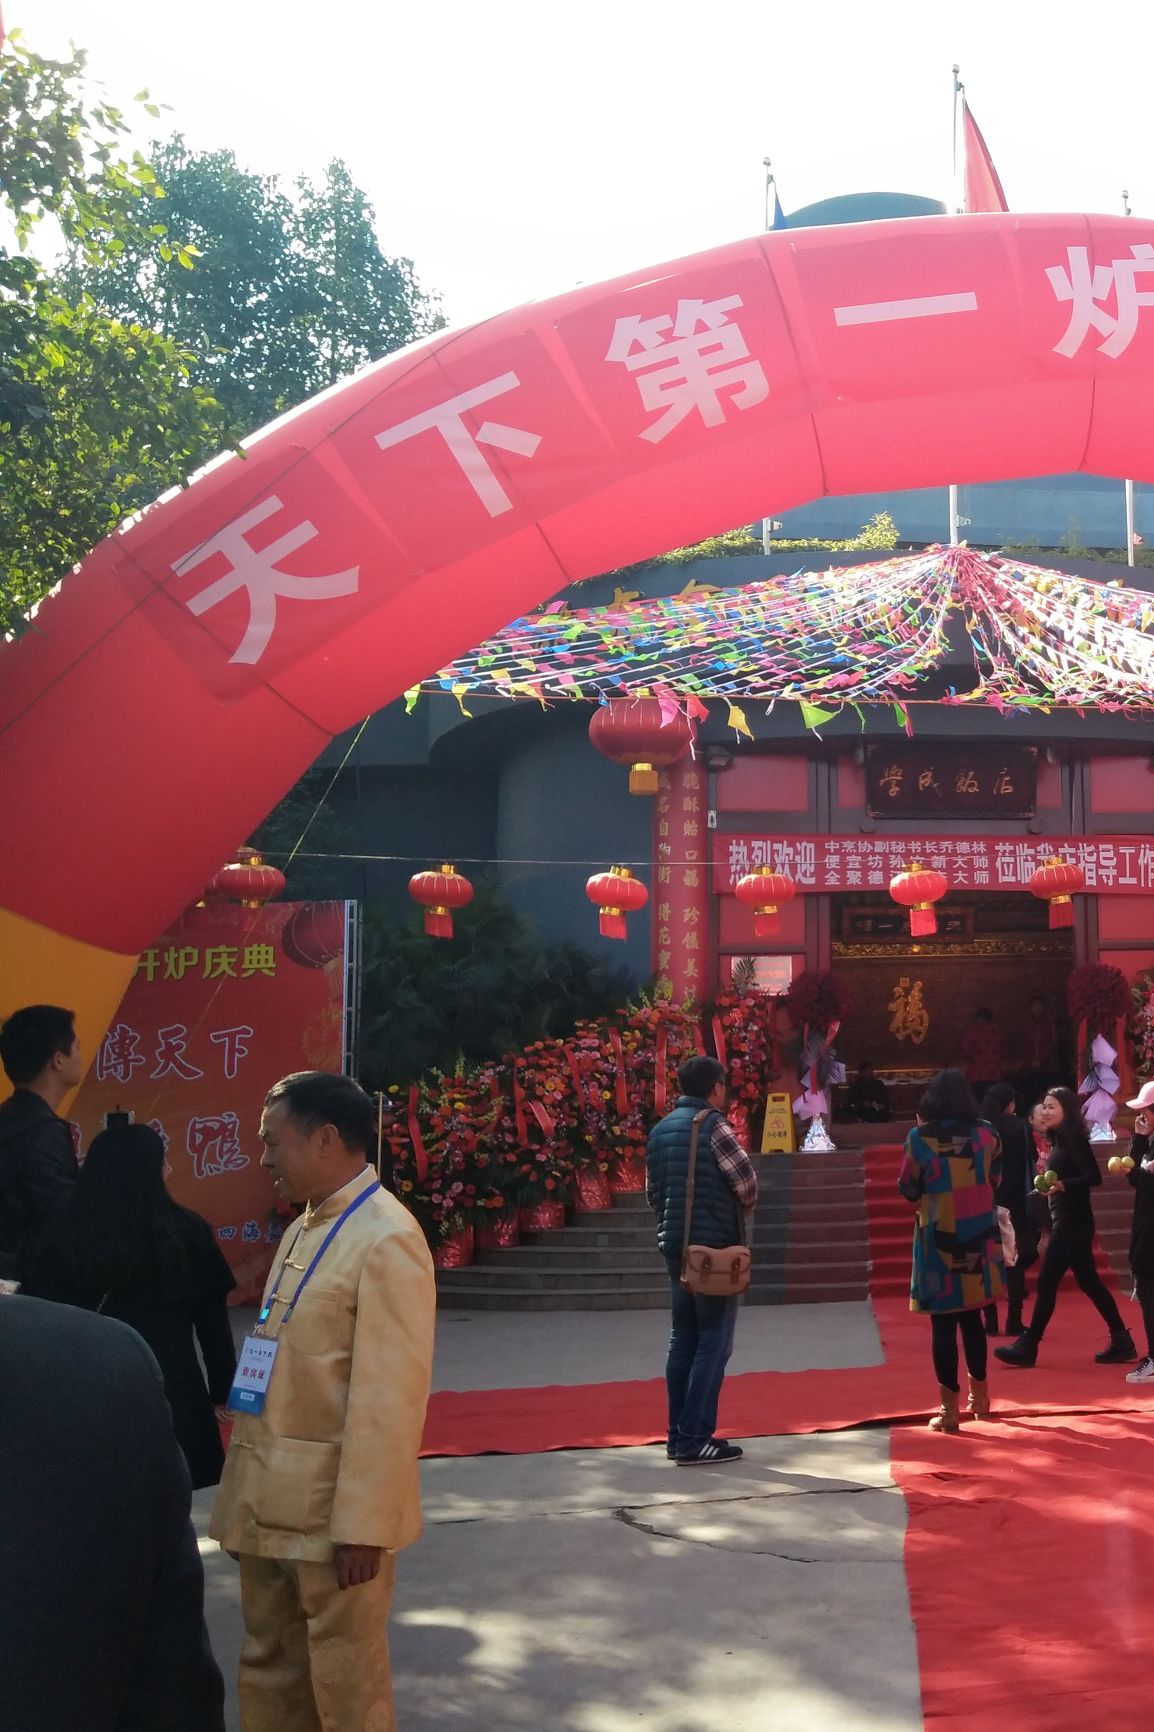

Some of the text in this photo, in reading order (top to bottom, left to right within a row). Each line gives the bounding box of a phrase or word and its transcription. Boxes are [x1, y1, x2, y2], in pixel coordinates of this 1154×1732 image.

[729, 839, 817, 886] 热烈欢迎
[823, 870, 990, 886] 全聚德大师
